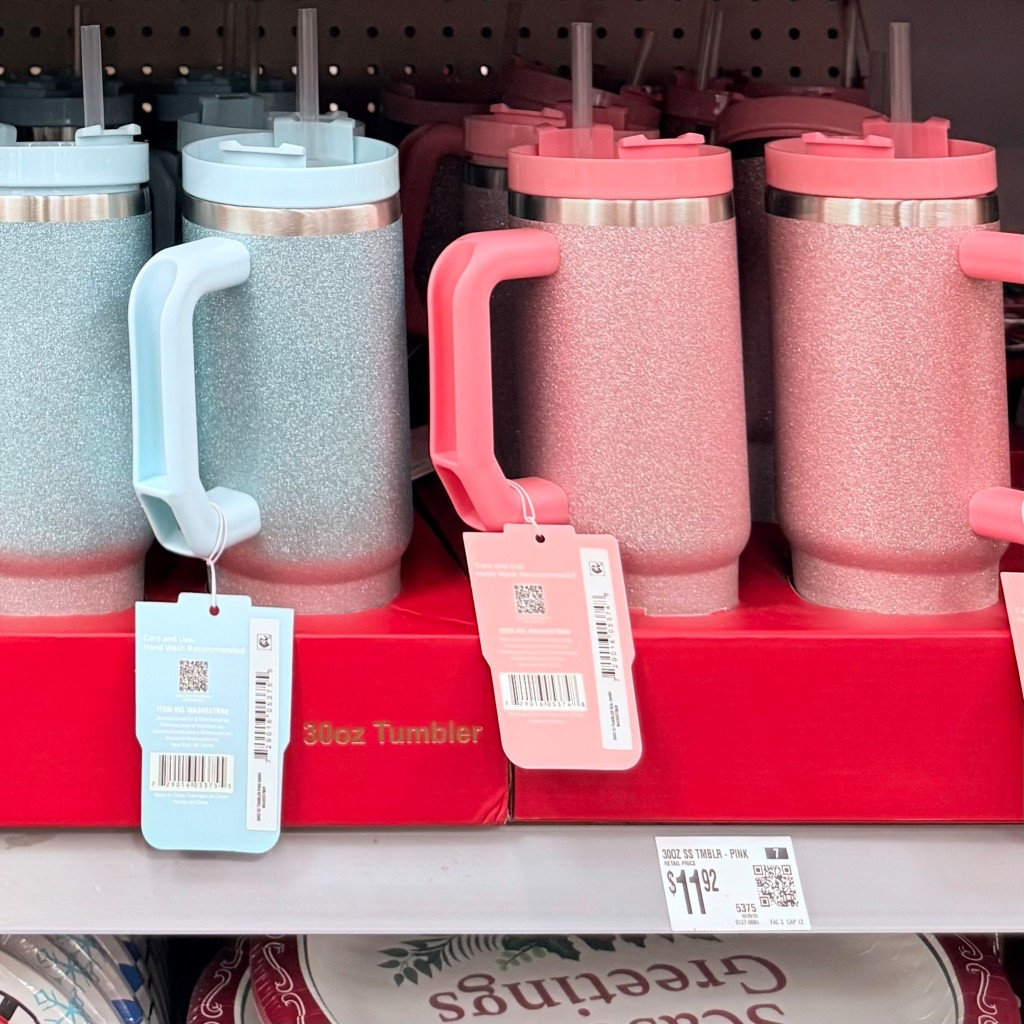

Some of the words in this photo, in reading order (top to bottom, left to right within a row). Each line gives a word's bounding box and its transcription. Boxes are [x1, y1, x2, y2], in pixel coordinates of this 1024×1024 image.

[304, 722, 366, 745] 30oz
[373, 720, 483, 745] Tumbler
[684, 849, 694, 859] SS
[695, 849, 722, 859] TMBLR
[730, 849, 749, 859] PINK
[773, 848, 779, 859] 7
[736, 903, 757, 913] 5375
[429, 954, 788, 1022] Greetings
